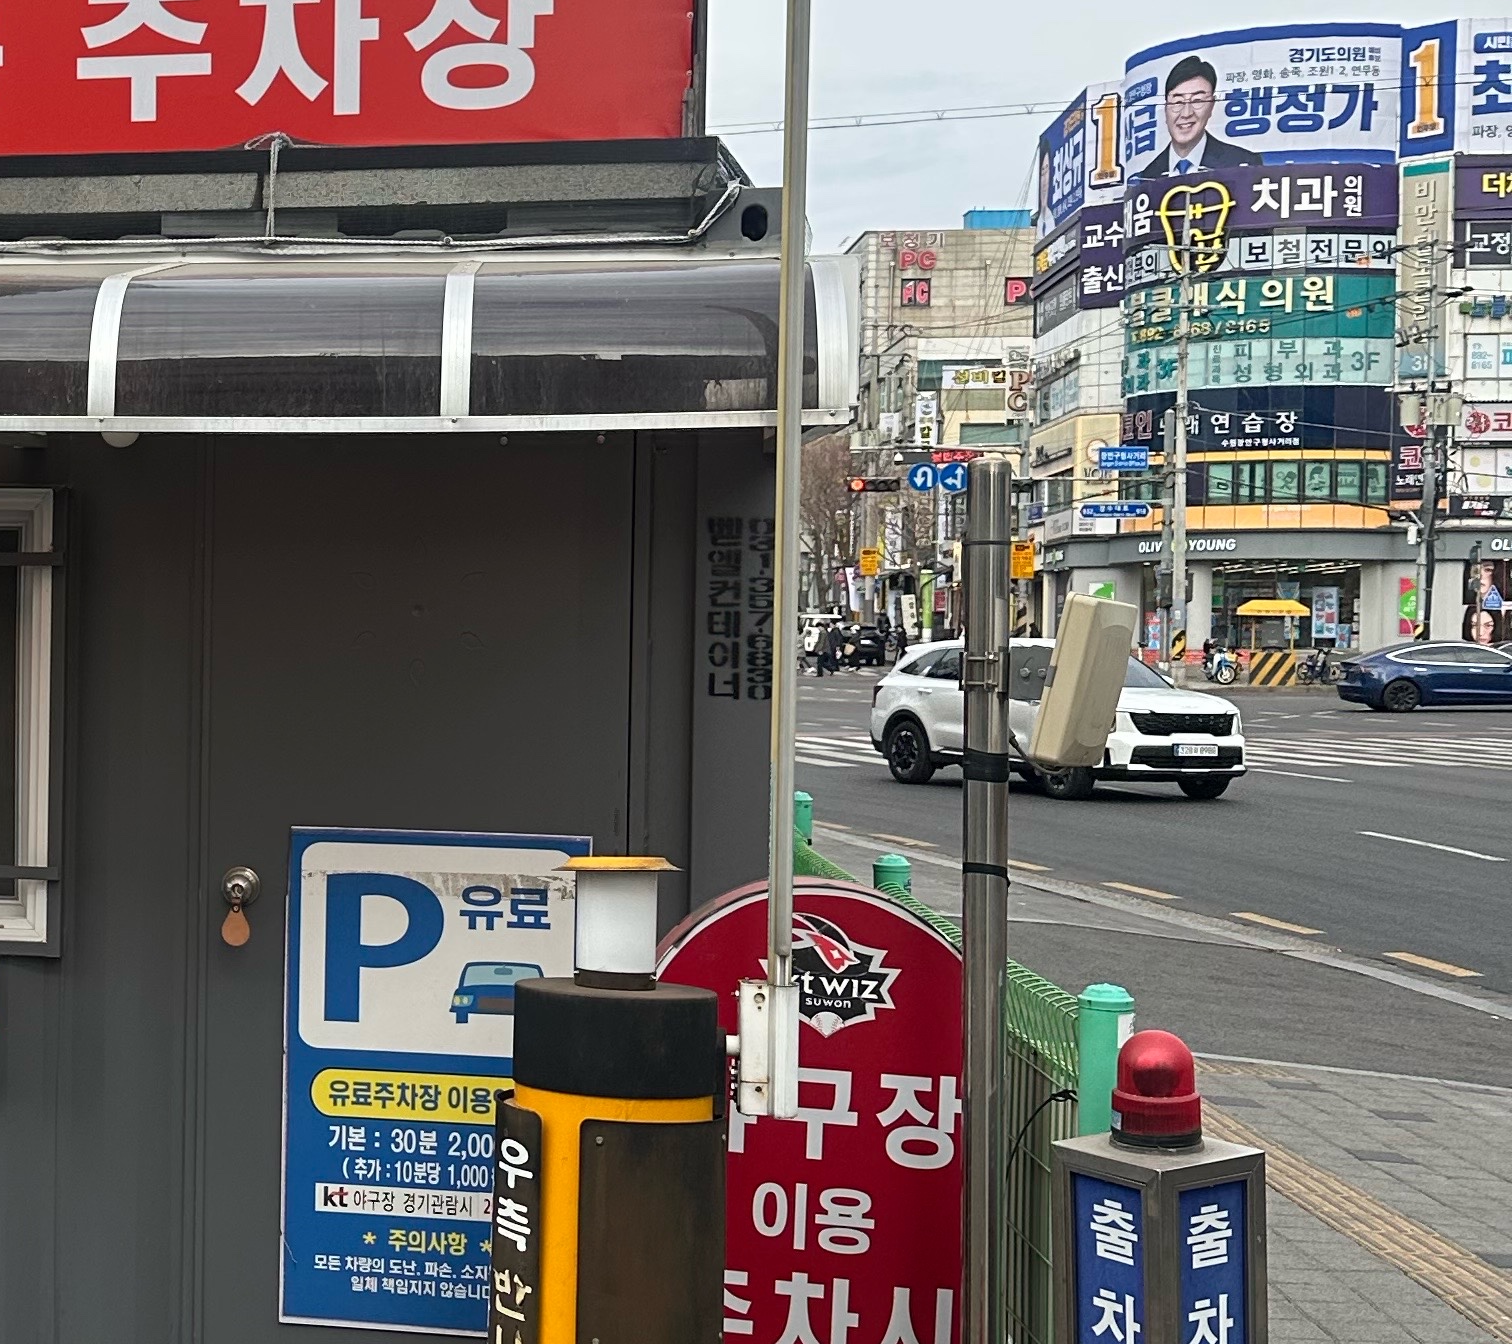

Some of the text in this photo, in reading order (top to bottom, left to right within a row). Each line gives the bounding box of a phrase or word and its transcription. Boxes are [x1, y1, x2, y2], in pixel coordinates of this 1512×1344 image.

[1289, 47, 1366, 63] 경기도의원
[1408, 39, 1445, 140] 1
[1224, 83, 1379, 138] 행정가
[1088, 92, 1126, 191] 1
[1251, 175, 1338, 218] 치과
[1343, 175, 1363, 216] 의원
[1082, 221, 1125, 248] 교수
[899, 249, 936, 271] PC
[1245, 237, 1393, 268] 보철전문의
[1081, 263, 1124, 295] 출신
[1259, 275, 1335, 313] 의원
[1234, 340, 1344, 360] 피부과
[1351, 352, 1380, 371] 3F
[1007, 370, 1030, 413] PC
[1188, 539, 1236, 551] YOUNG
[460, 885, 552, 931] 유료
[324, 872, 445, 1023] P
[328, 1080, 498, 1114] 유료주차장 이용
[328, 1125, 366, 1152] 기본
[390, 1128, 437, 1155] 30분
[447, 1132, 495, 1161] 2,00
[447, 1165, 495, 1188] 1,000
[323, 1186, 348, 1208] kt
[352, 1191, 395, 1213] 야구장
[403, 1192, 473, 1217] 경기관람시
[497, 1137, 534, 1252] 우측
[752, 1182, 875, 1254] 이용
[388, 1229, 468, 1255] 주의사항
[314, 1254, 342, 1271] 모든
[345, 1256, 385, 1274] 차량의
[460, 1264, 491, 1281] 소지
[350, 1275, 377, 1293] 일체
[381, 1277, 436, 1296] 책임지지
